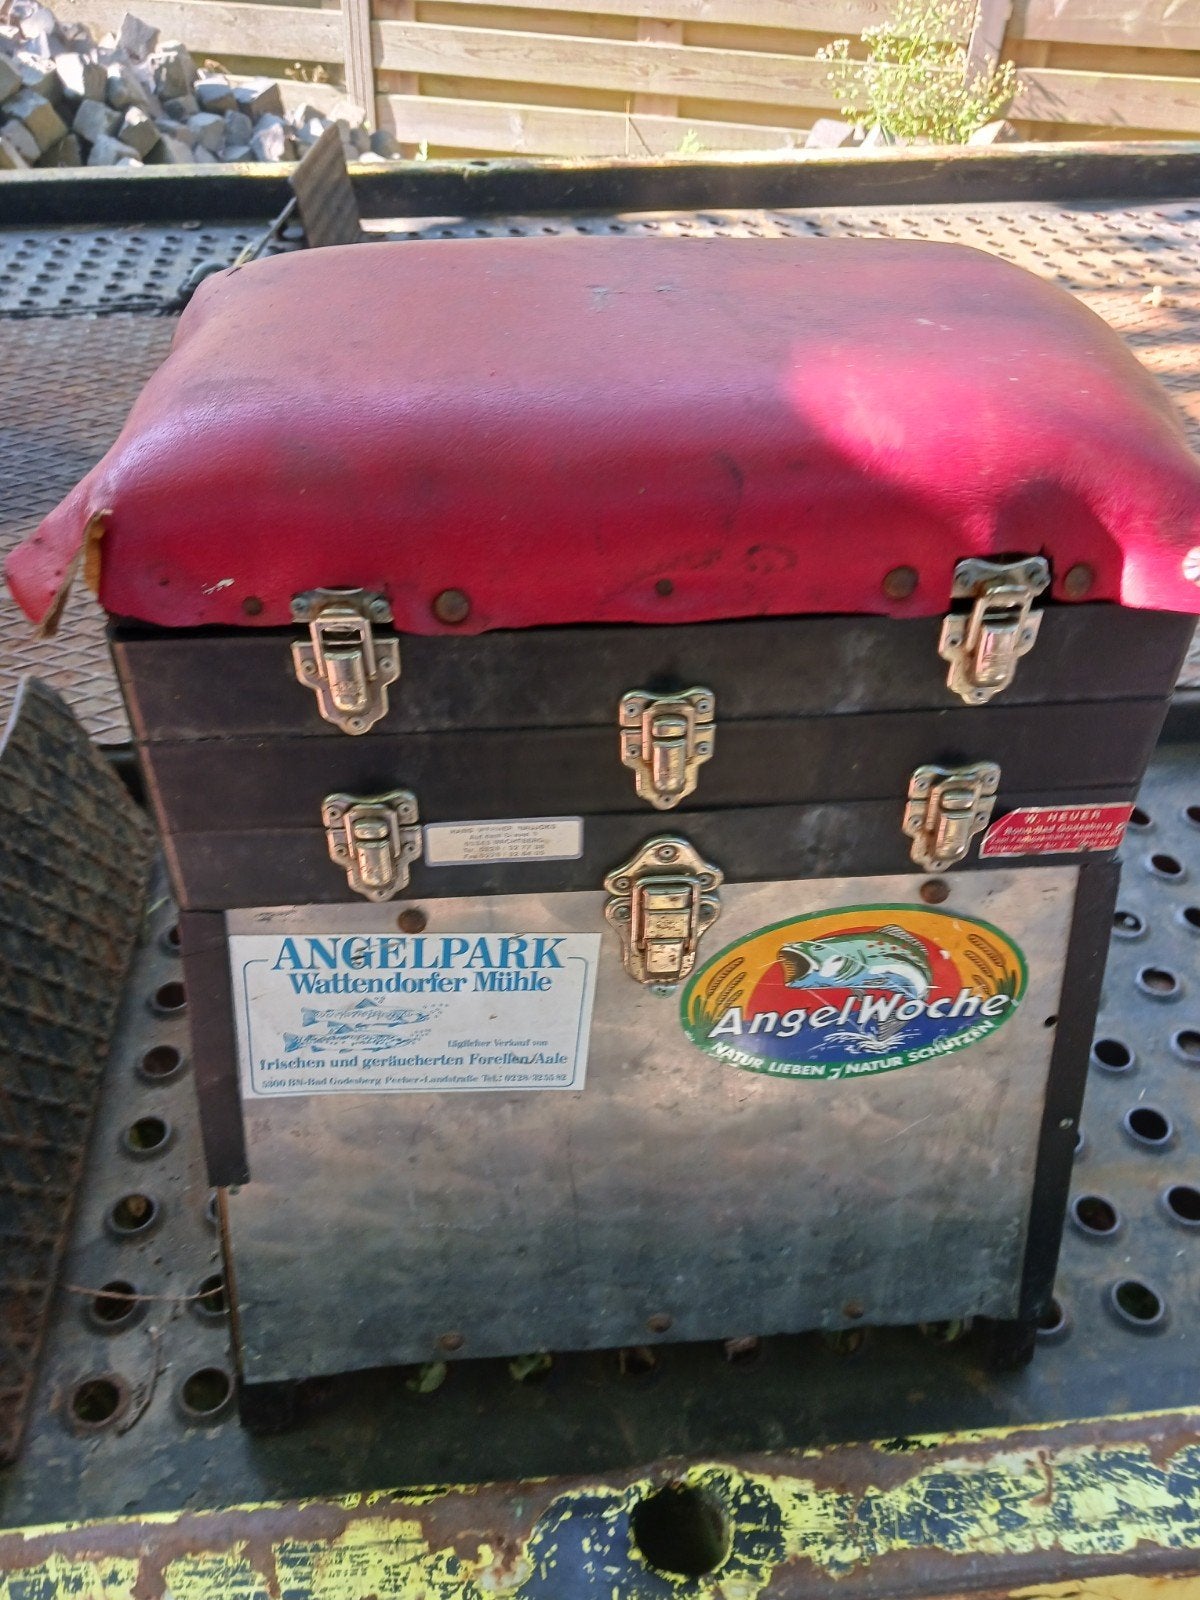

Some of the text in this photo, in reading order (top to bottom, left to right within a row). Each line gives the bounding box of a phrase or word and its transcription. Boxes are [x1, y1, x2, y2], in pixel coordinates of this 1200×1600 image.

[271, 936, 567, 970] ANGELPARK
[286, 970, 552, 994] Wattendorfer Mühle
[706, 987, 1011, 1039] AngelWoche
[260, 1057, 325, 1070] frischen
[330, 1055, 359, 1068] und
[362, 1053, 464, 1069] geräucherten
[711, 1041, 763, 1070] NATUR
[768, 1060, 826, 1076] LIEBEN
[845, 1055, 903, 1075] NATUR
